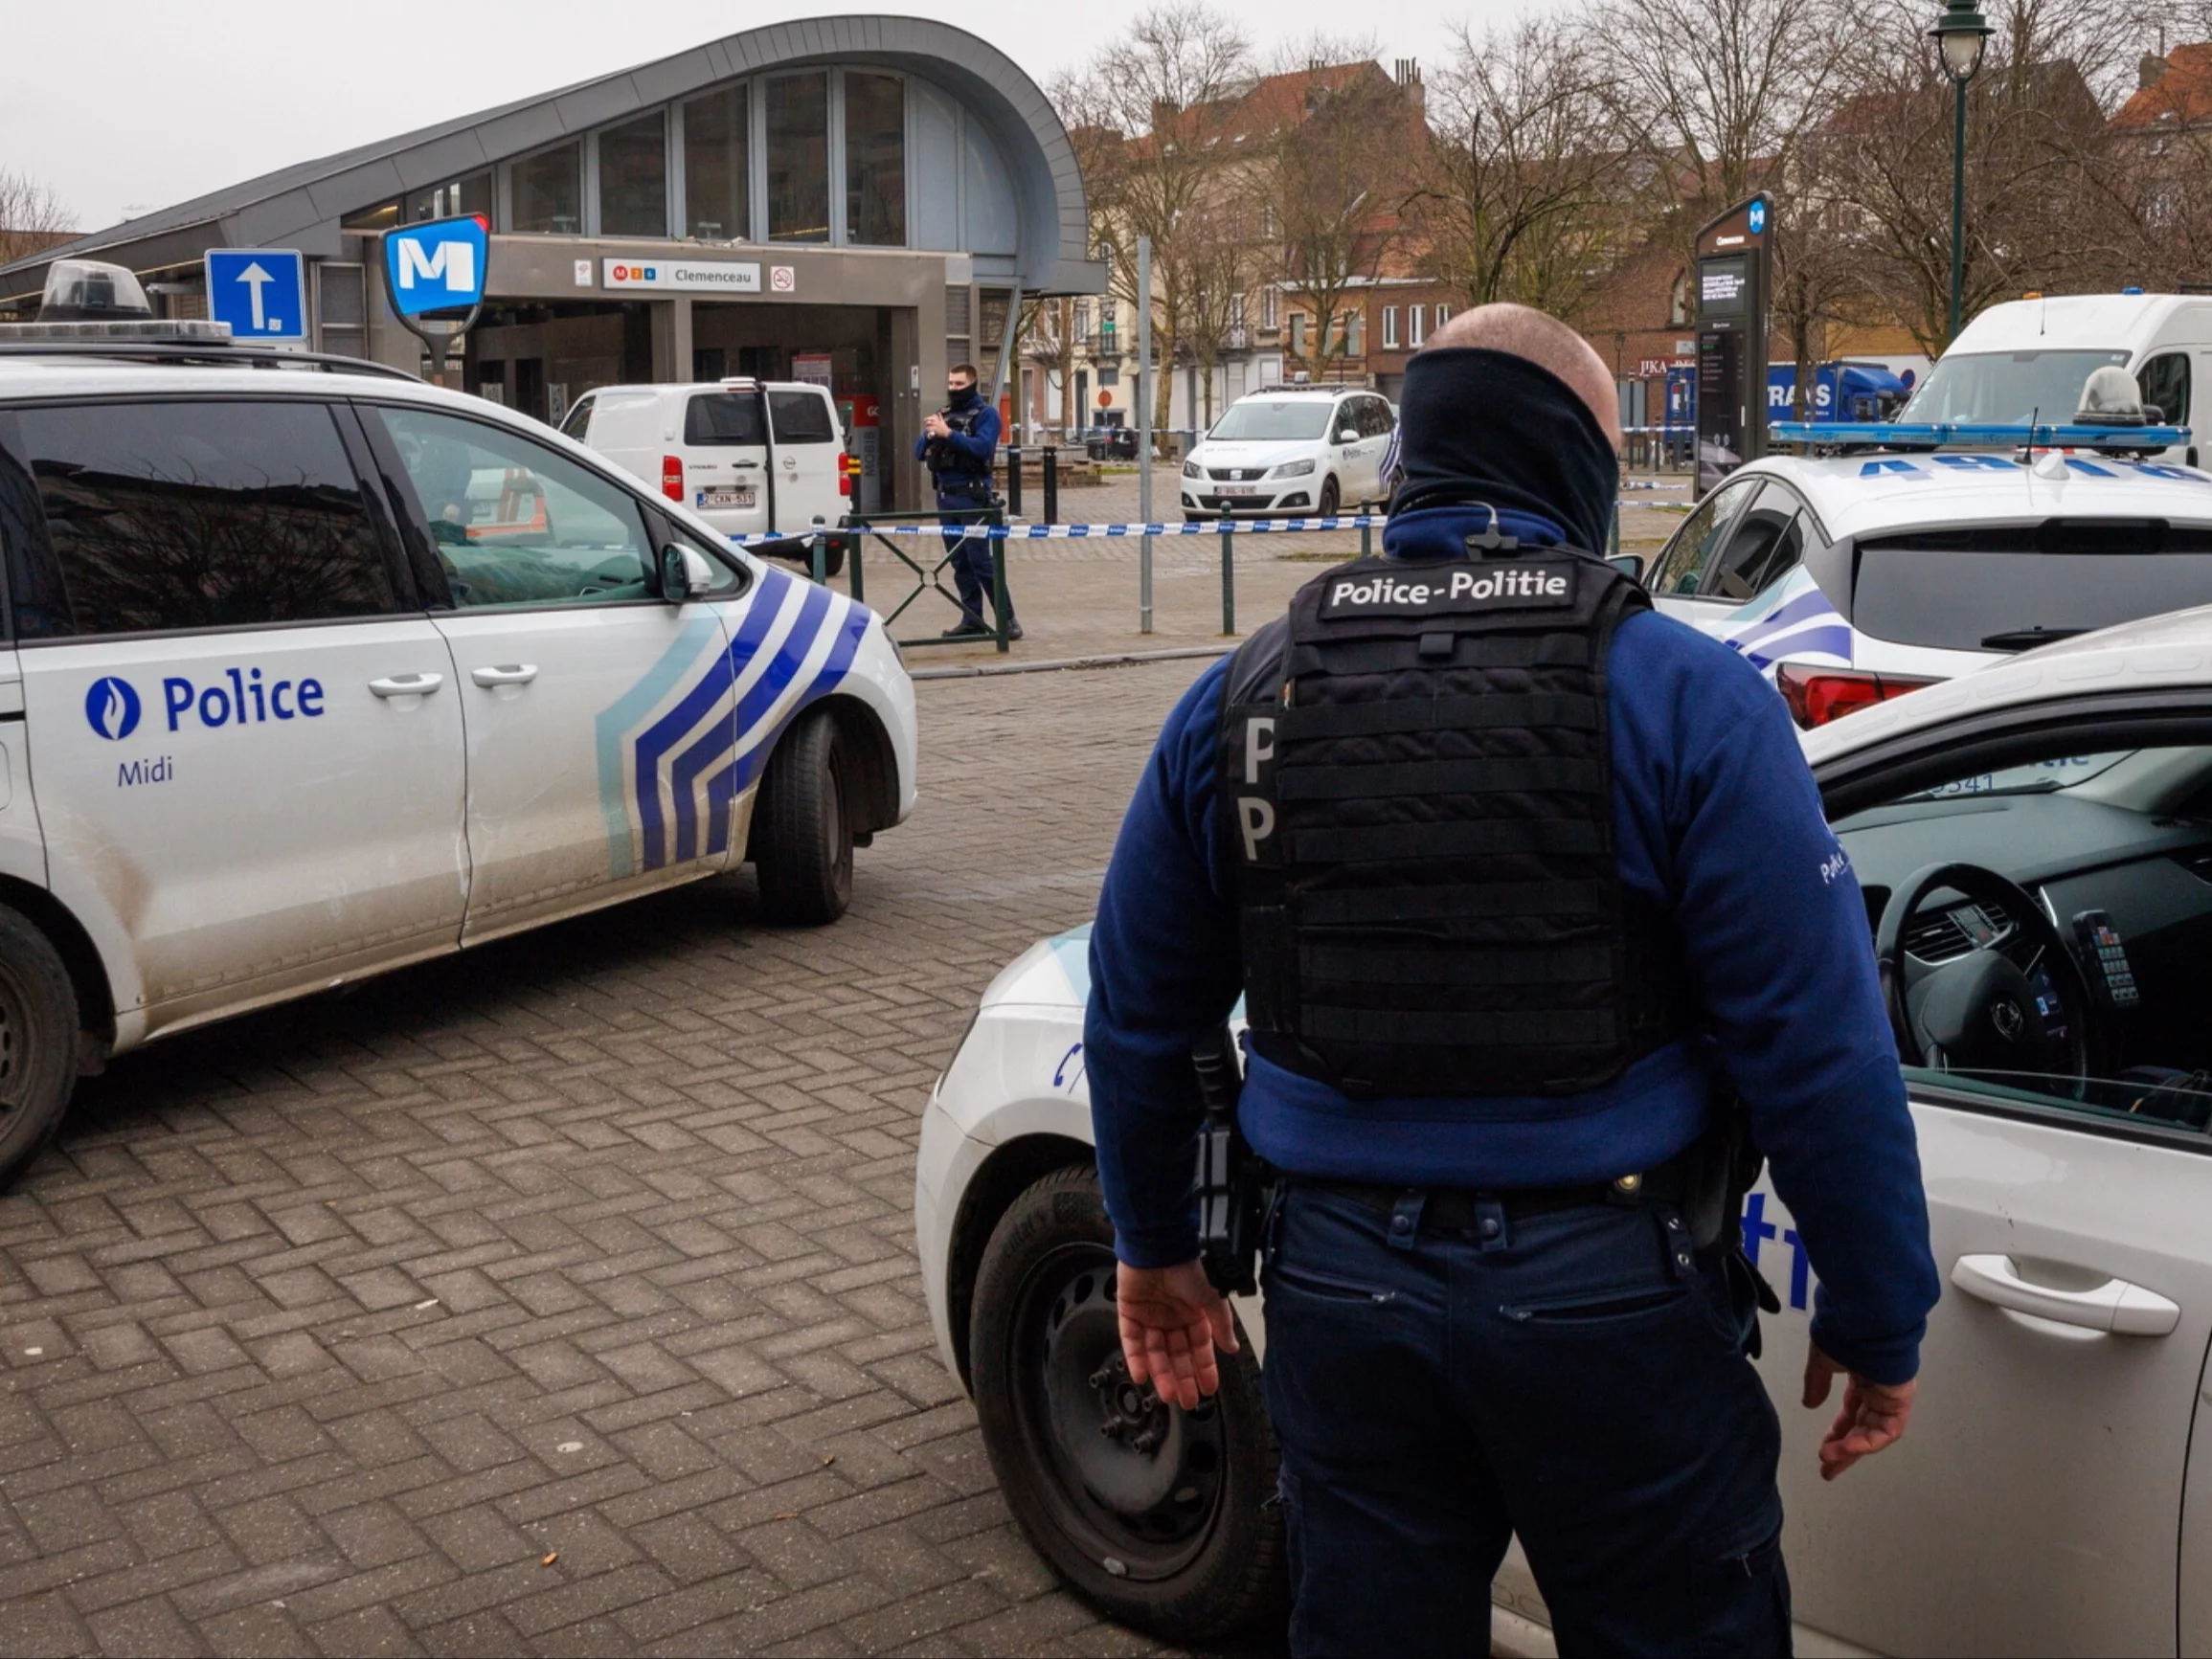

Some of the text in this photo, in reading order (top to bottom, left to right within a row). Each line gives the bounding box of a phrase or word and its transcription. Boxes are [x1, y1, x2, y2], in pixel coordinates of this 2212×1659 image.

[397, 237, 476, 292] M
[675, 268, 752, 283] Clemenceau
[163, 667, 325, 732] Police
[118, 756, 173, 788] Midi
